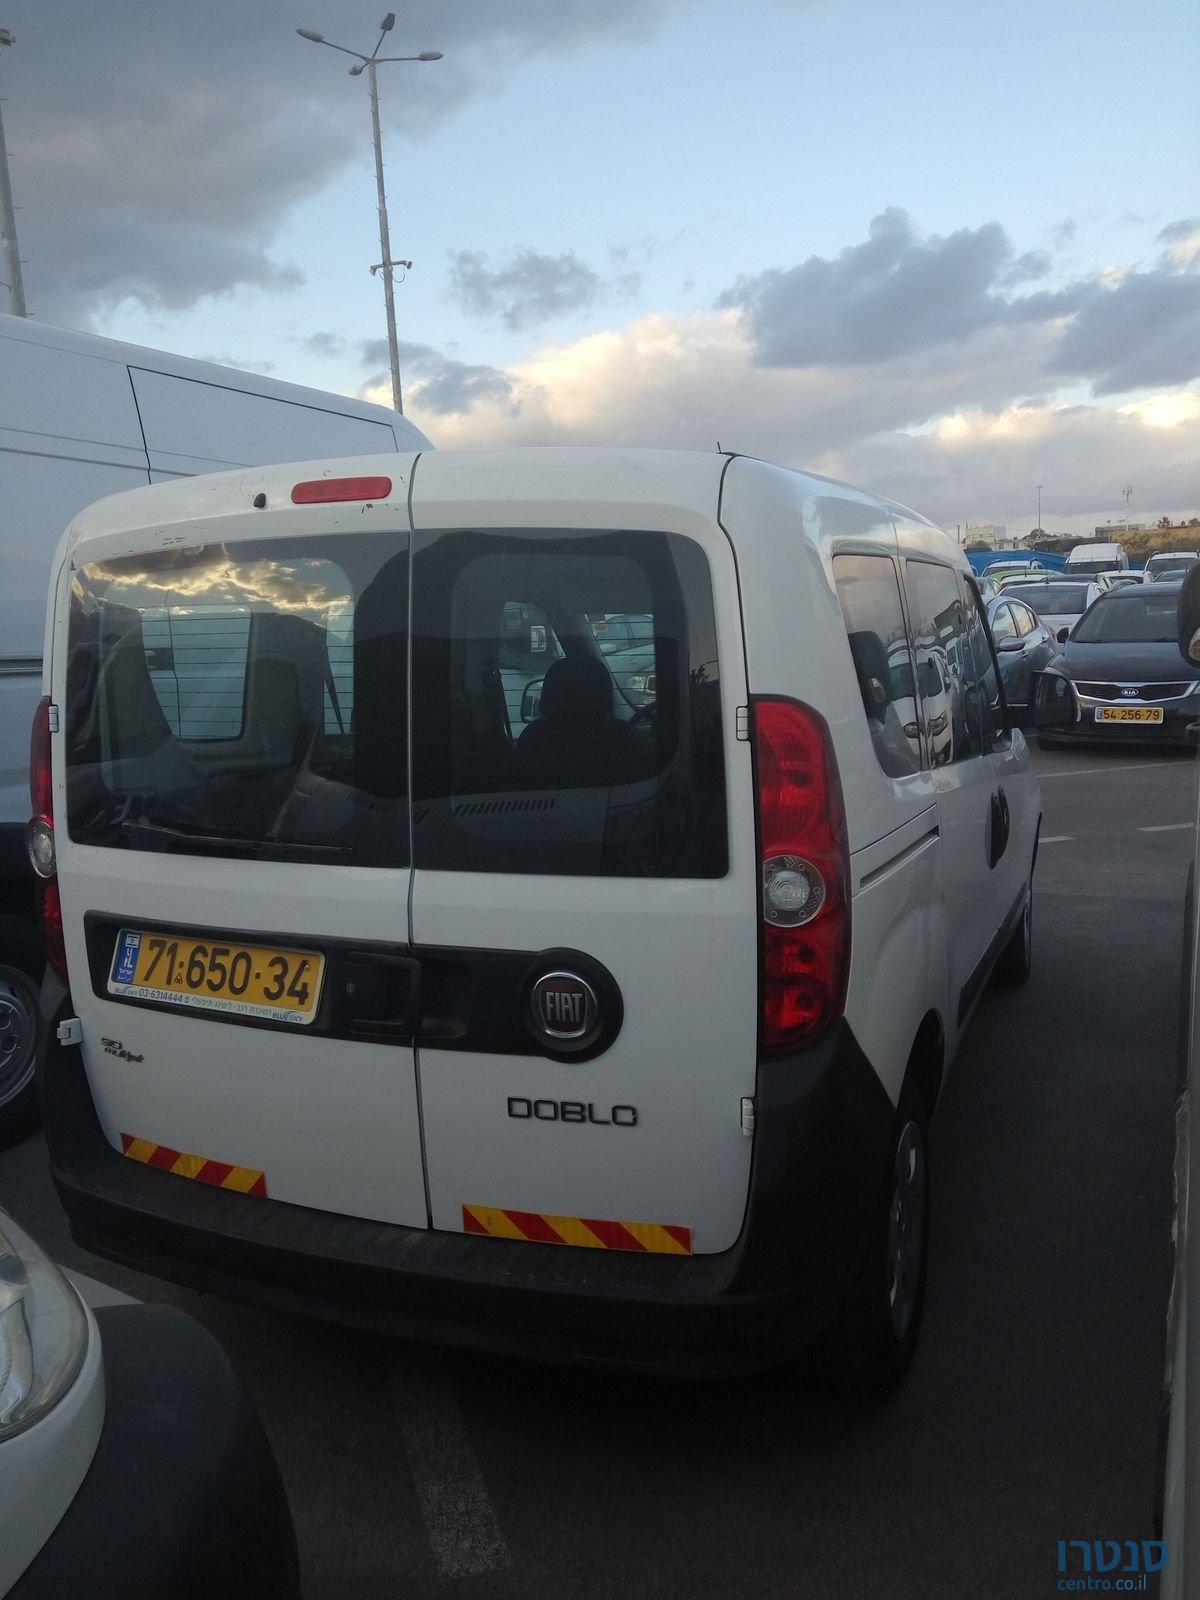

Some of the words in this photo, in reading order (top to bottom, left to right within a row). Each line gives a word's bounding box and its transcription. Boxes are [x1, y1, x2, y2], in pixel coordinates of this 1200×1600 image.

[139, 988, 183, 1002] 03-6314444
[272, 1012, 289, 1021] BLUE
[545, 991, 583, 1022] FIAT
[507, 1096, 638, 1126] DOBLO
